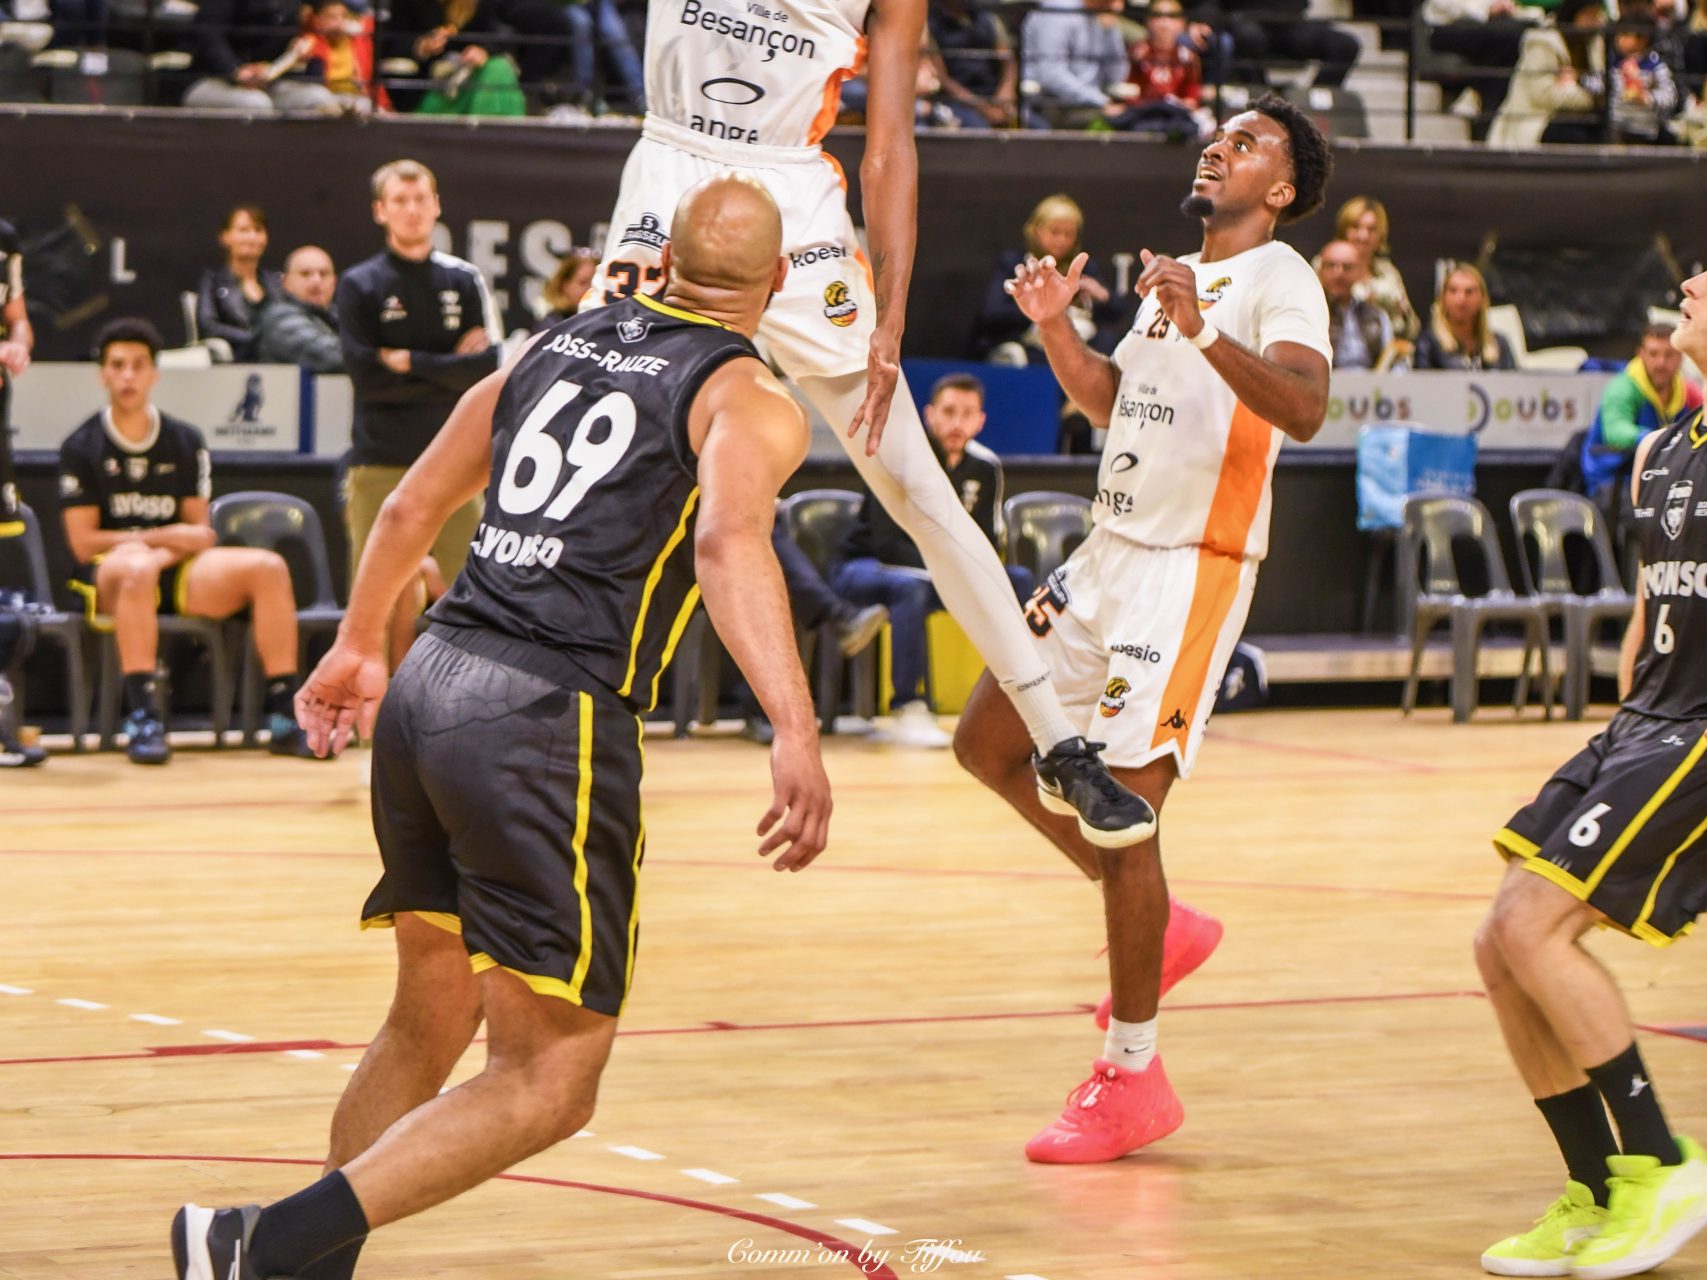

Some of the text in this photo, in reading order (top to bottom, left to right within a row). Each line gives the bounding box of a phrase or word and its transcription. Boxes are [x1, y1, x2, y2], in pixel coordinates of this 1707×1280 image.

[772, 9, 789, 23] de
[788, 245, 848, 269] koesi
[1324, 386, 1411, 422] oubs
[497, 379, 637, 522] 69
[1653, 603, 1675, 655] 6
[1567, 802, 1613, 848] 6
